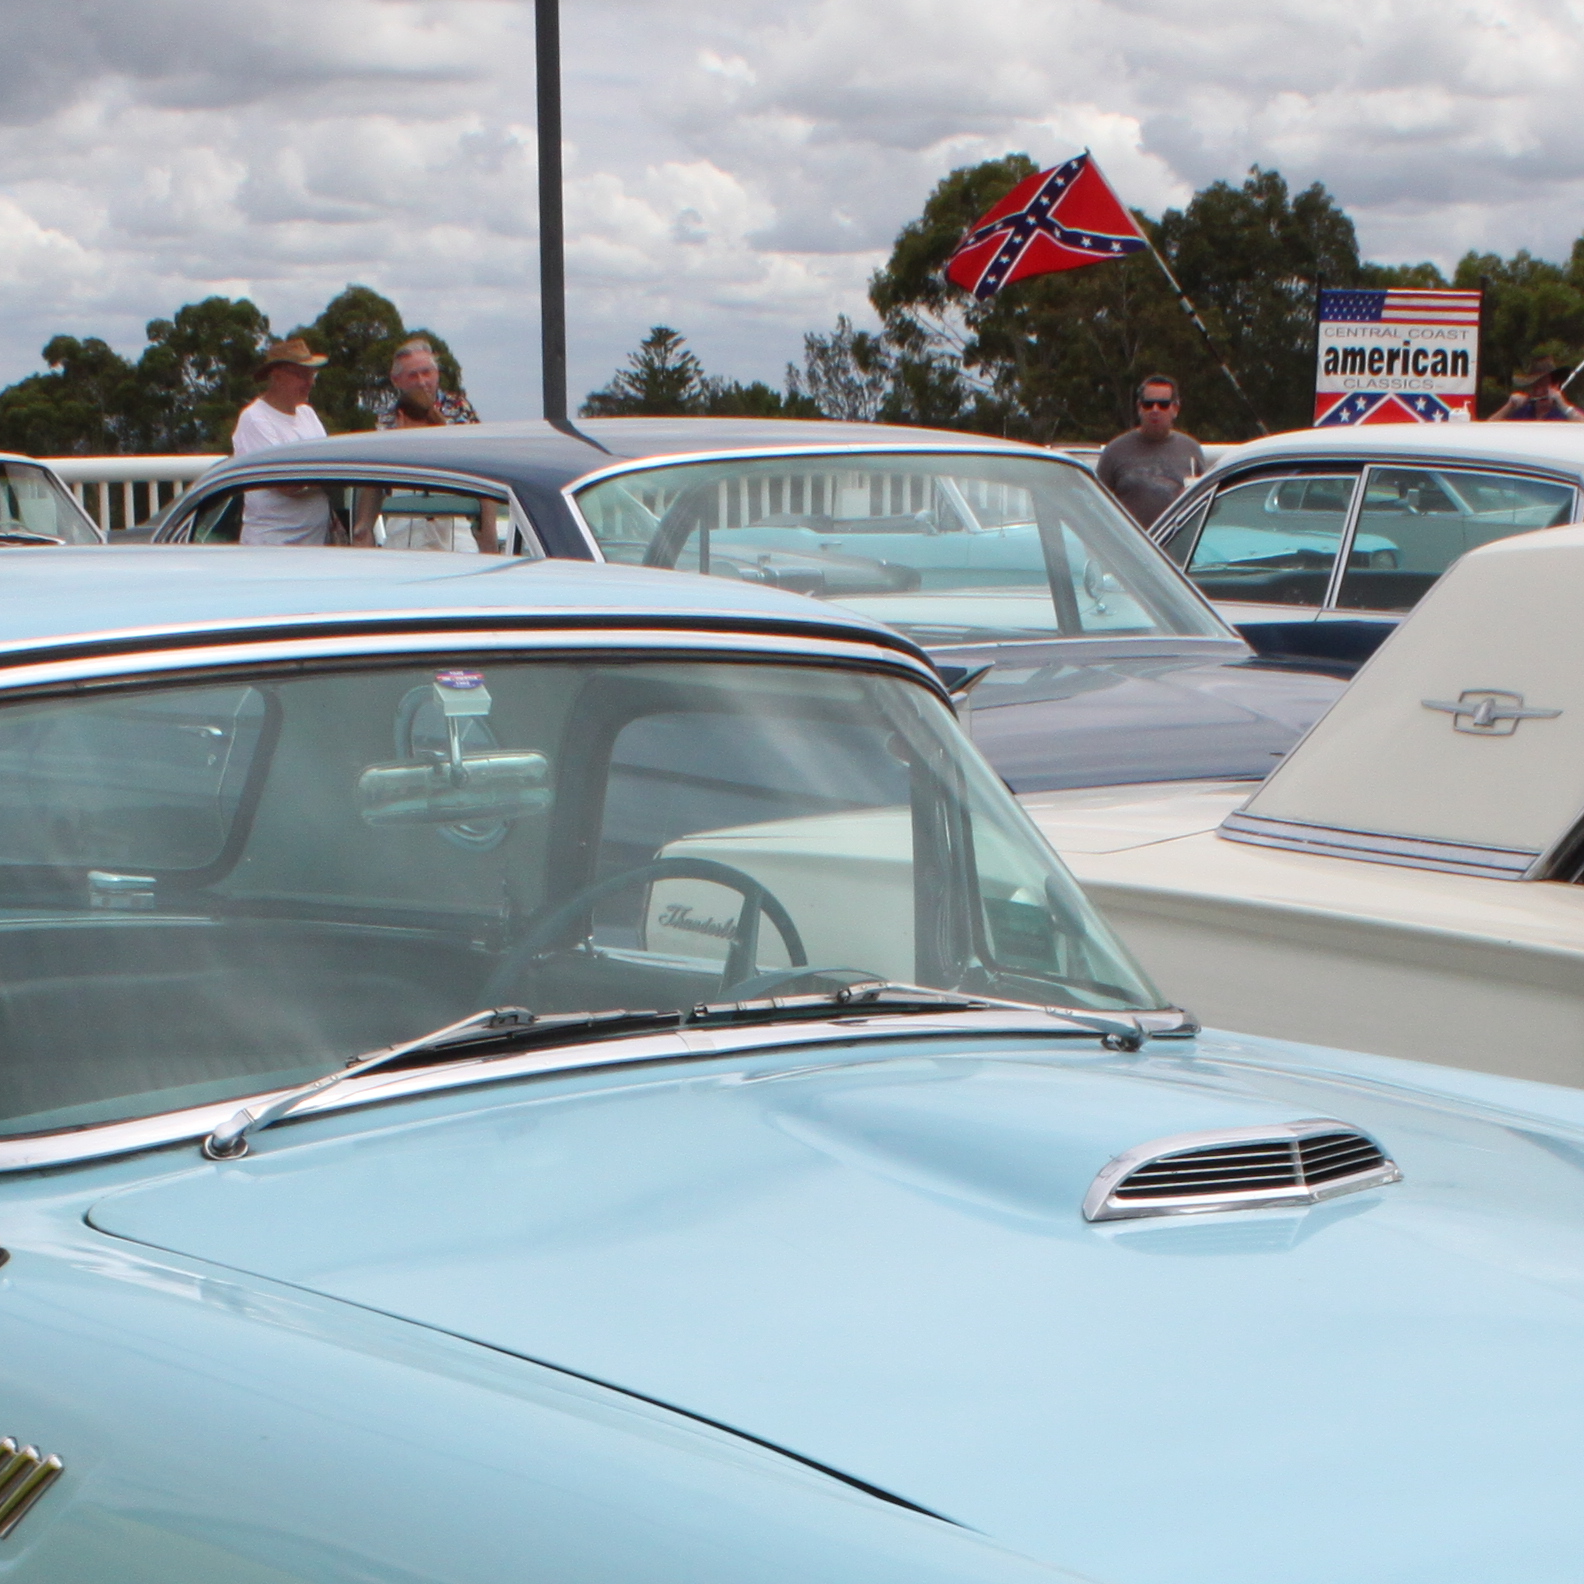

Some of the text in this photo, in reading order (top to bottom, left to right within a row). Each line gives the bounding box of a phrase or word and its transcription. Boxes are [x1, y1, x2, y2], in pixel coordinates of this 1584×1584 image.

[1323, 326, 1471, 341] CENTRAL COAST
[1323, 339, 1470, 378] american
[1342, 377, 1435, 391] CLASSICS
